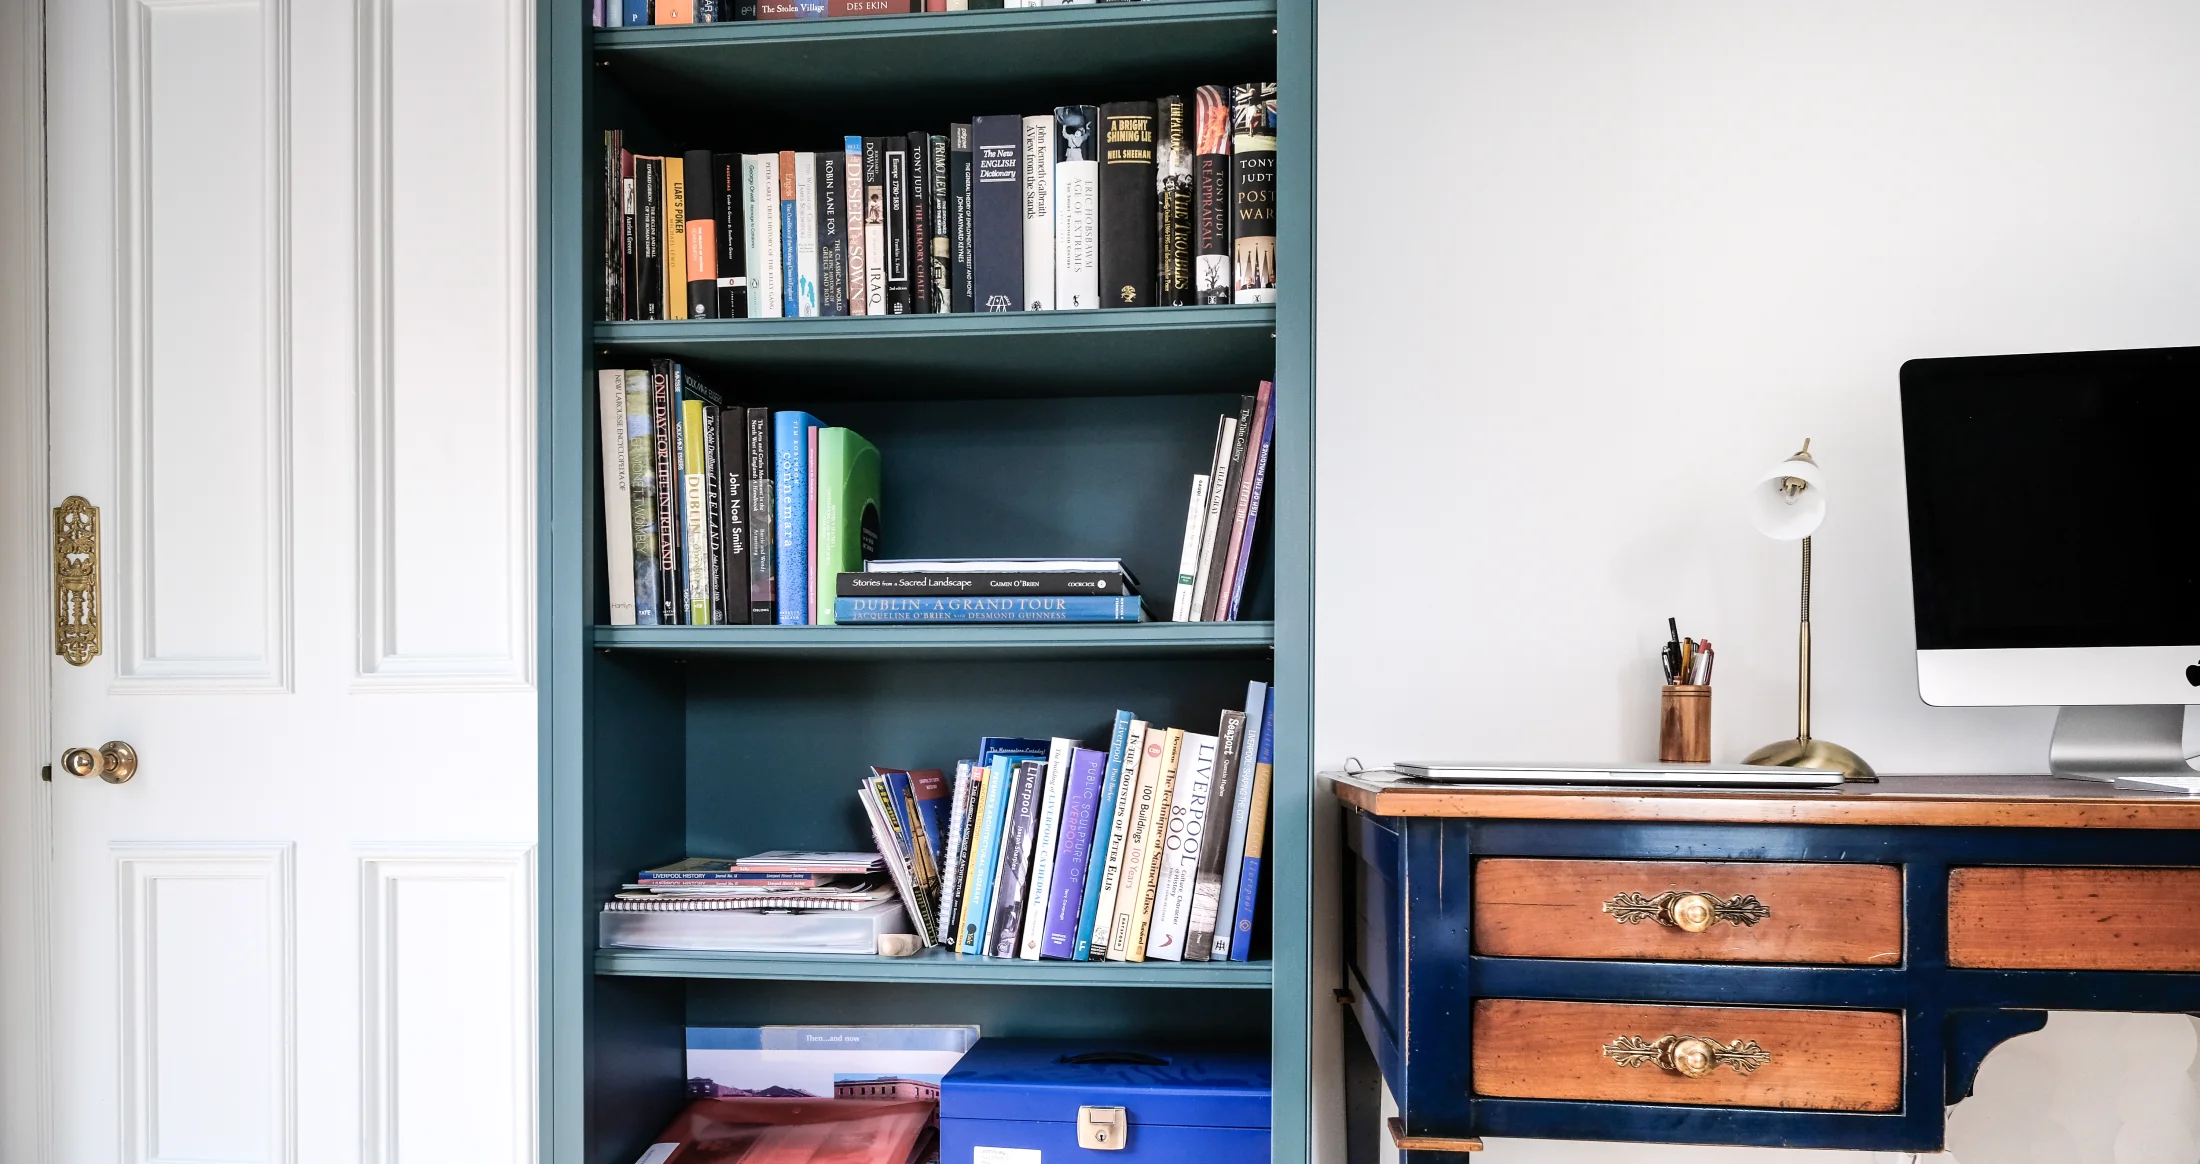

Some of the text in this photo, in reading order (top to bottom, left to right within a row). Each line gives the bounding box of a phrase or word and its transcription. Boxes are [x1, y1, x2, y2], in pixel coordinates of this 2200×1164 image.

[762, 4, 825, 13] The Stolen Village
[846, 0, 888, 10] DES EKIN
[1107, 130, 1152, 143] SHINING LIE
[1112, 120, 1148, 131] A BRIGHT
[826, 160, 834, 188] ROBIN
[890, 158, 900, 179] Europe
[936, 142, 946, 197] PRIMO LEVI
[980, 159, 1016, 168] ENGLISH
[980, 170, 1016, 178] Dictionary
[1036, 126, 1047, 217] John Kenneth Galbraith
[1108, 150, 1152, 160] NEIL SHEEHAN
[1240, 160, 1274, 169] TONY
[784, 174, 792, 196] Engels
[914, 175, 922, 200] JUDT
[1242, 172, 1274, 184] JUDT
[674, 182, 684, 234] LIAR'S POKER
[847, 163, 862, 236] DESERT
[1202, 160, 1212, 249] REAPPRAISALS
[1216, 171, 1224, 239] TONY JUDT
[1240, 208, 1274, 220] WAR
[1074, 178, 1082, 273] AGE OF EXTREMES
[1084, 180, 1093, 268] ERIC HOBSBAWM
[1174, 192, 1192, 290] THE TROUBLES
[768, 248, 773, 256] OF
[849, 246, 864, 300] SOWN
[869, 268, 882, 304] IRAQ
[916, 264, 924, 300] CHALET
[1232, 409, 1250, 463] The Tate Gallery
[632, 454, 644, 495] MONET
[654, 374, 672, 570] ONE DAY FOR LIFE IN IRELAND
[1210, 466, 1226, 516] EILEEN GRAY
[688, 477, 700, 534] DUBLIN
[730, 473, 744, 554] John Noel Smith
[783, 452, 794, 548] connemara
[633, 497, 646, 554] TWOMBLY
[854, 598, 1066, 610] DUBLIN A GRAND TOUR
[1106, 720, 1128, 802] Liverpool Paul Barker
[1218, 718, 1241, 798] Seaport Quentin Hughes
[1244, 730, 1256, 766] LIVERPOOL:
[986, 772, 999, 808] PEVSNER'S
[1166, 769, 1177, 786] The
[1240, 768, 1250, 795] SHAPING
[1010, 767, 1038, 871] Liverpool Joseph Sharples
[1063, 795, 1082, 855] LIVERPOOL
[1070, 762, 1098, 884] PUBLIC SCULPTURE OF
[1104, 734, 1140, 892] IN THE FOOTSTEPS OF PETER ELLIS
[1154, 787, 1174, 838] Technique
[1180, 744, 1216, 867] LIVERPOOL
[1236, 808, 1244, 824] CITY
[1243, 711, 1276, 914] Maritime Mercantile City Liverpool
[978, 810, 994, 867] ARCHITECTURAL
[1125, 785, 1154, 890] 100 Buildings 100 Years
[1154, 839, 1163, 849] of
[1166, 806, 1187, 851] 800
[972, 870, 984, 905] GLOSSARY
[1147, 851, 1162, 888] Stained
[1058, 899, 1068, 921] Cavanagh
[1142, 888, 1155, 916] Glass
[1173, 870, 1187, 926] Culture, Character
[1117, 918, 1126, 948] BATSFORD
[1138, 921, 1148, 945] Batsford
